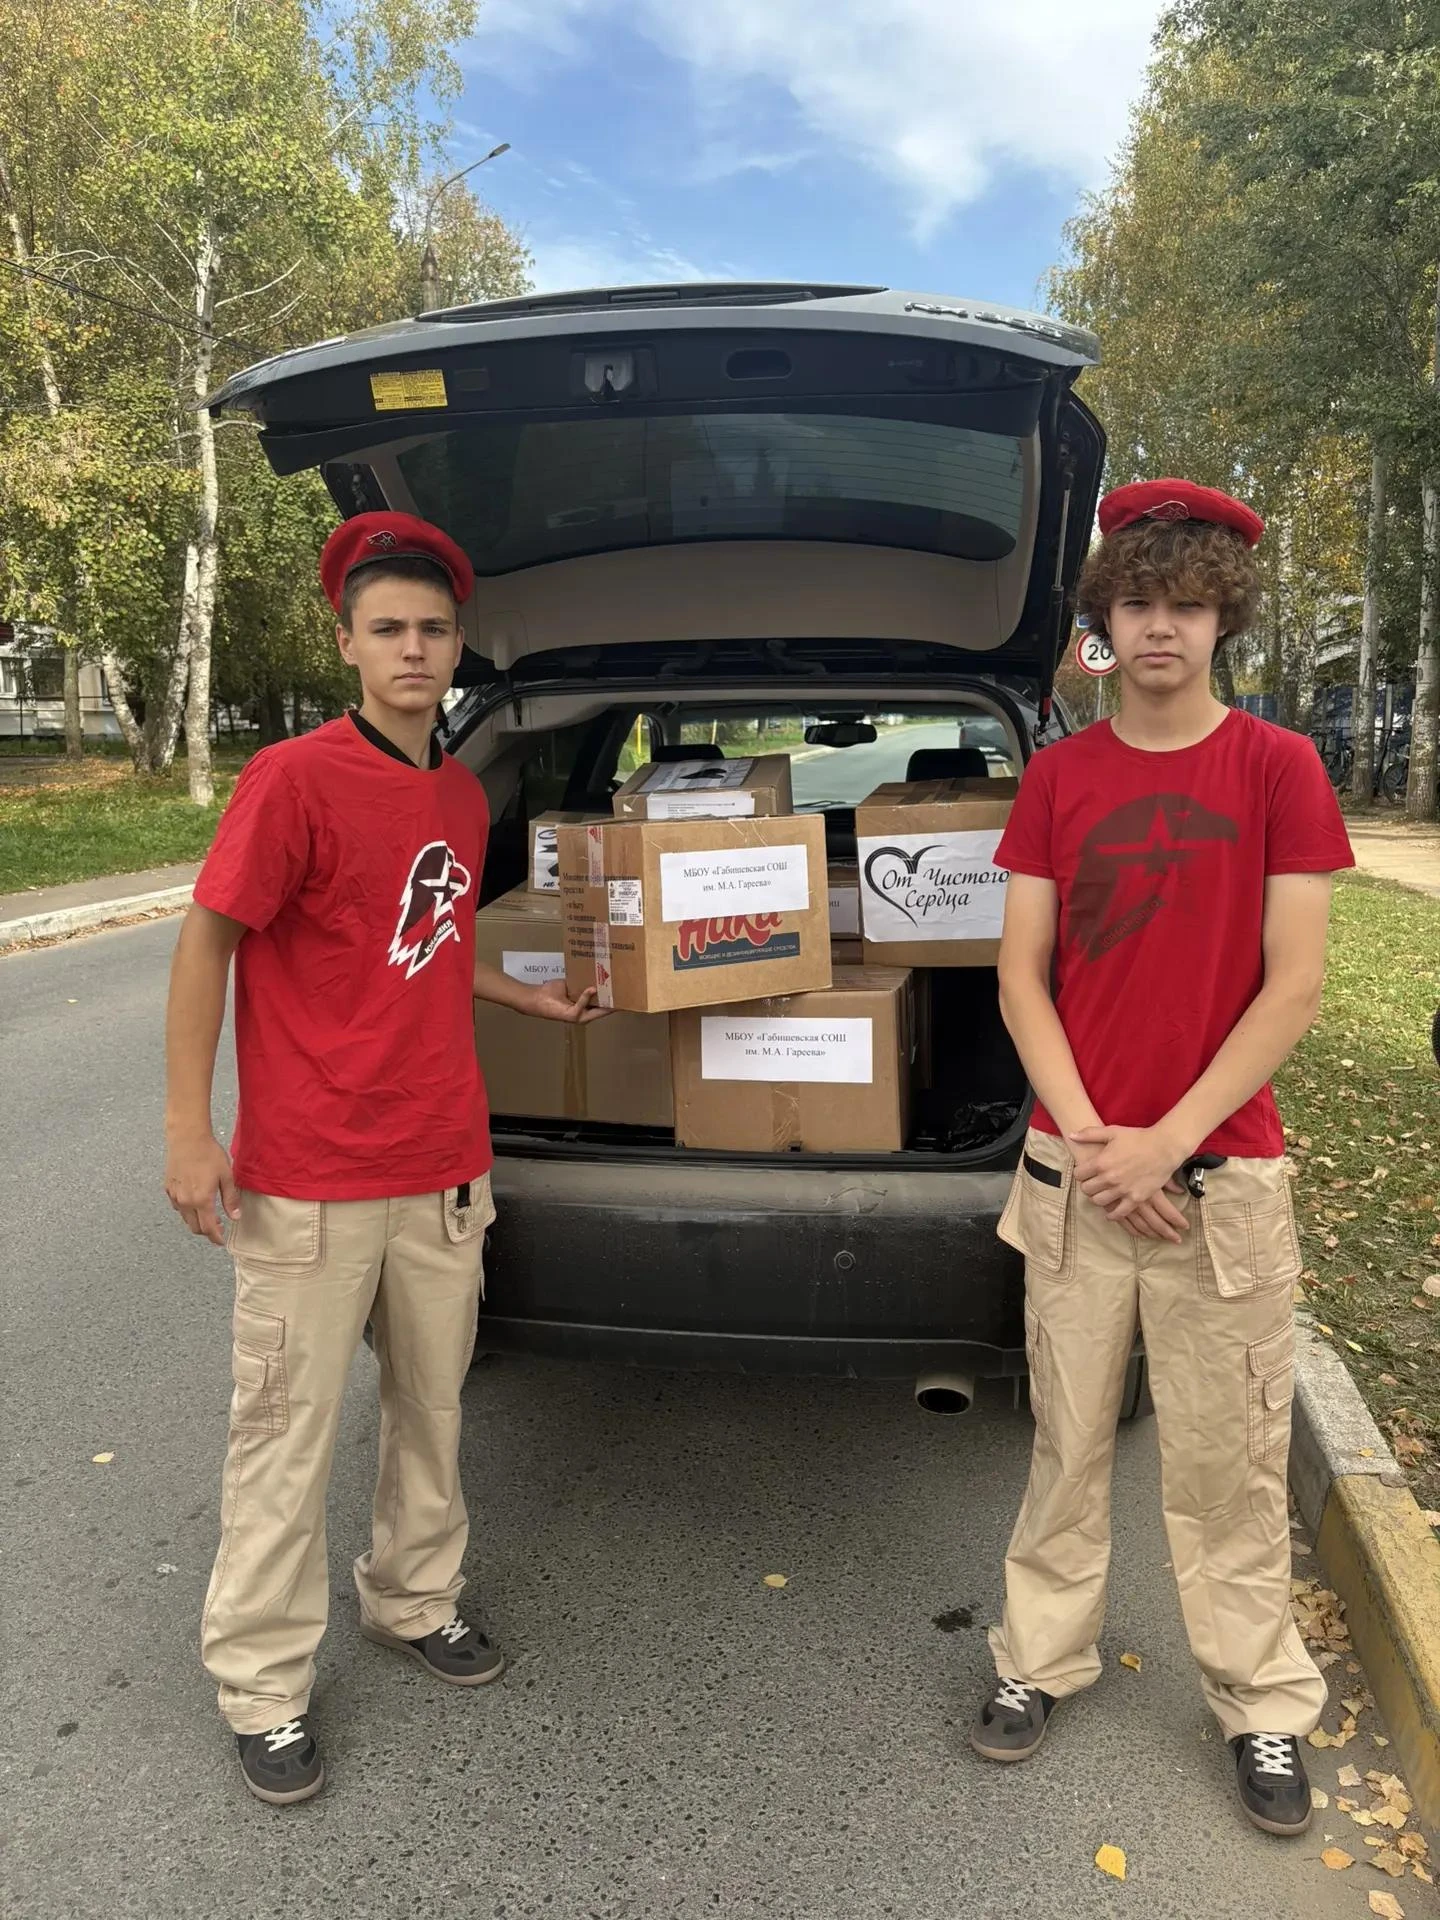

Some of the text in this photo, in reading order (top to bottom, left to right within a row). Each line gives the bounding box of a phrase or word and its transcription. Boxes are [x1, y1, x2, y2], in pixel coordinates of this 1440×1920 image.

[1088, 644, 1111, 660] 20
[683, 866, 710, 878] МБОУ
[766, 861, 788, 871] СОШ
[882, 867, 1011, 890] От Чистого
[703, 884, 716, 892] им.
[718, 881, 737, 891] М.А.
[905, 887, 971, 916] Сердца
[524, 964, 550, 974] МБОУ
[725, 1032, 754, 1041] МБОУ
[821, 1033, 847, 1043] СОШ
[745, 1048, 760, 1056] им.
[762, 1047, 784, 1056] М.А.
